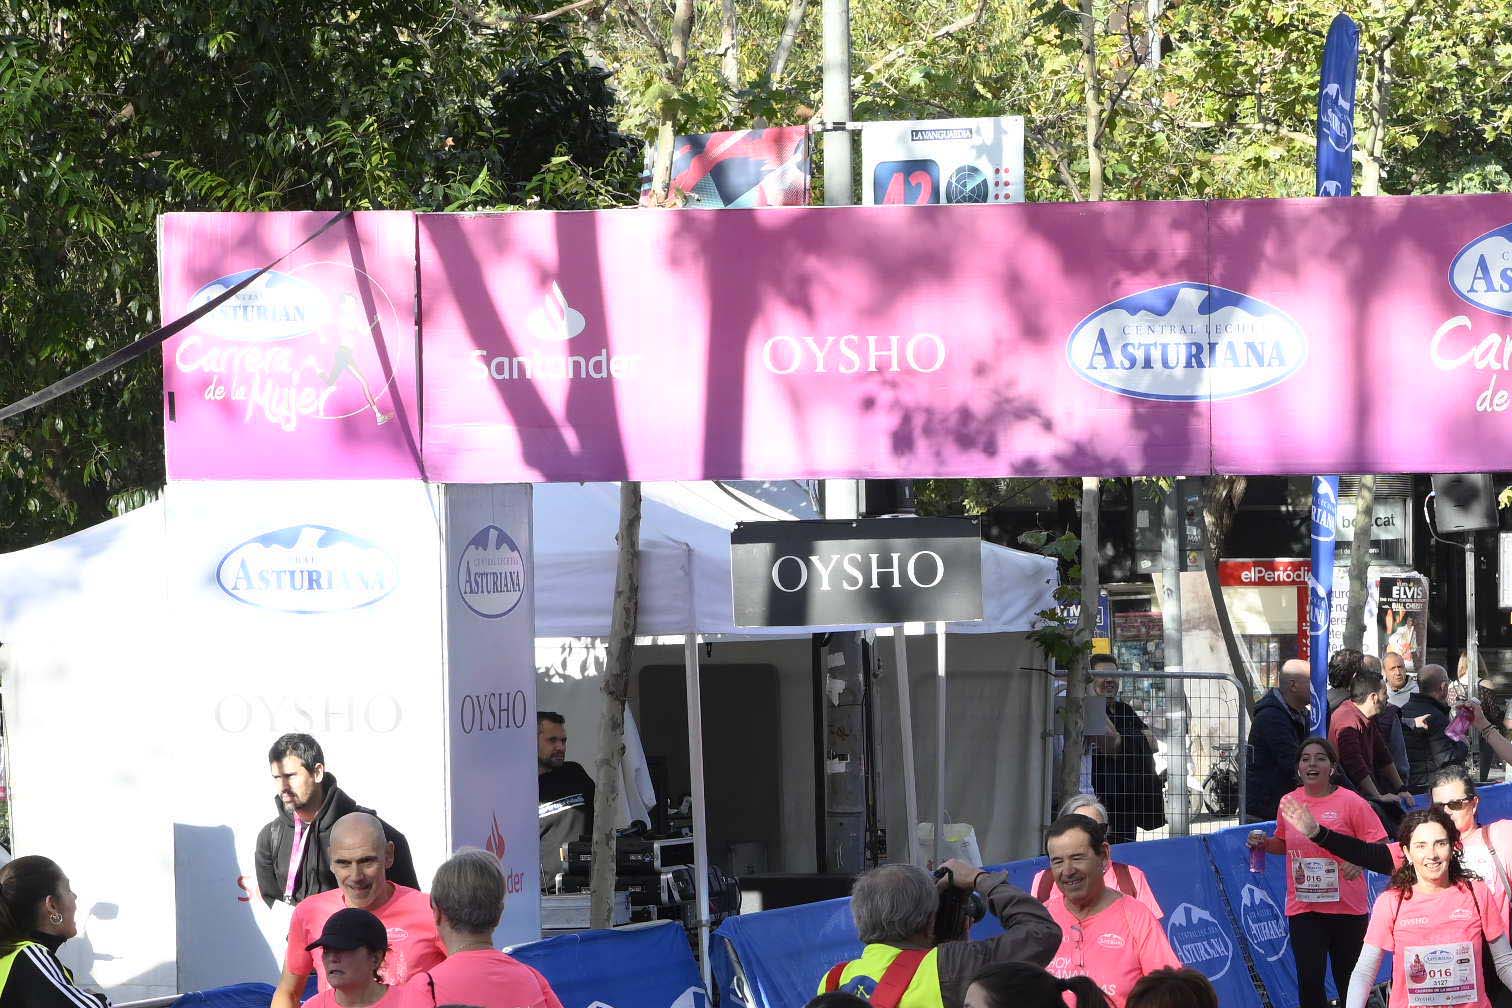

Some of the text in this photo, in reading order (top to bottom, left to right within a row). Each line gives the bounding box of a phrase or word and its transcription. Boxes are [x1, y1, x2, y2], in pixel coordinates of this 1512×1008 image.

[912, 129, 972, 140] LA VANGUARDIA
[1085, 327, 1287, 370] ASTURIANA
[1122, 325, 1197, 336] CENTRAL
[176, 335, 294, 372] Carrera
[761, 333, 946, 375] OYSHO
[204, 370, 336, 432] de la Mujer
[1476, 374, 1509, 413] de
[463, 569, 521, 596] ASTURIANA
[772, 550, 945, 592] OYSHO
[1241, 567, 1313, 583] elPeriódi
[1392, 586, 1422, 598] ELVIS
[460, 689, 527, 735] OYSHO
[1429, 969, 1451, 978] 016
